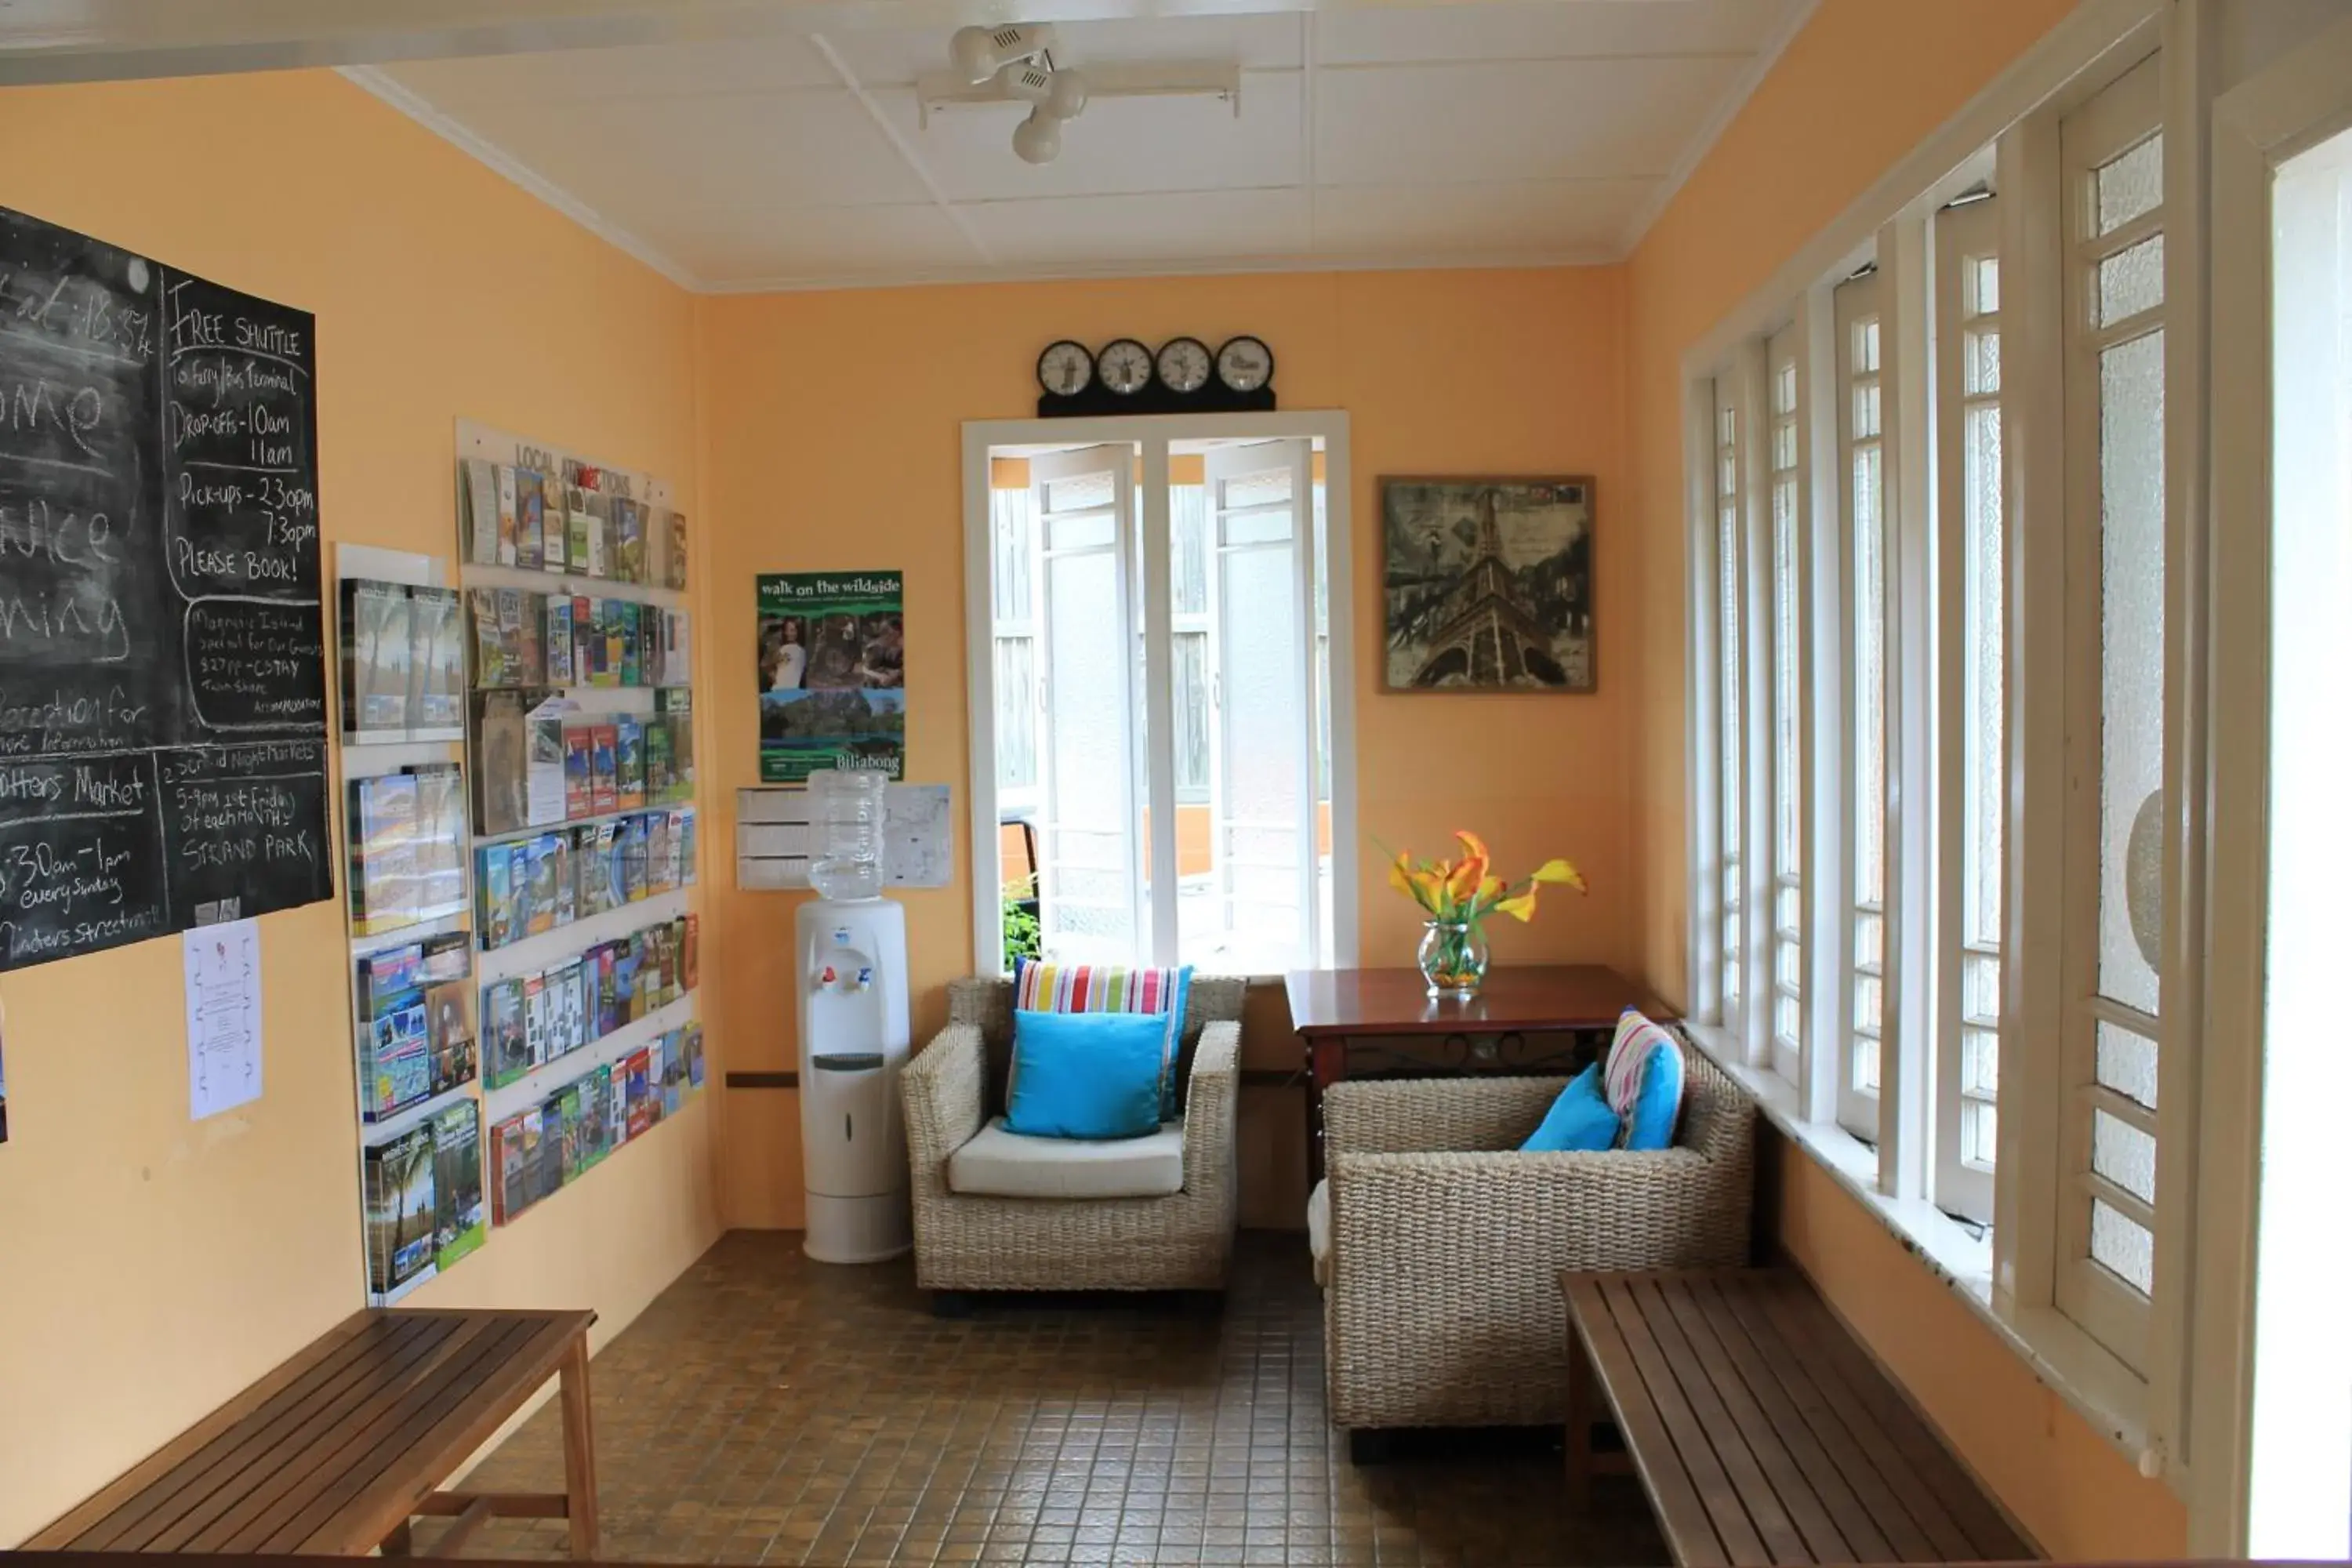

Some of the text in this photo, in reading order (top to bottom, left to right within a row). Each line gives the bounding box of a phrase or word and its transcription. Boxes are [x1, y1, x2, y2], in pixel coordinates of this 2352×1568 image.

[168, 280, 301, 357] FREE SHUTTLE
[250, 437, 293, 466] 11am
[515, 443, 554, 473] LOCAL
[175, 535, 236, 579] PLEASE
[761, 580, 794, 596] walk
[796, 586, 814, 597] on
[816, 579, 840, 594] the
[265, 829, 314, 863] PARK
